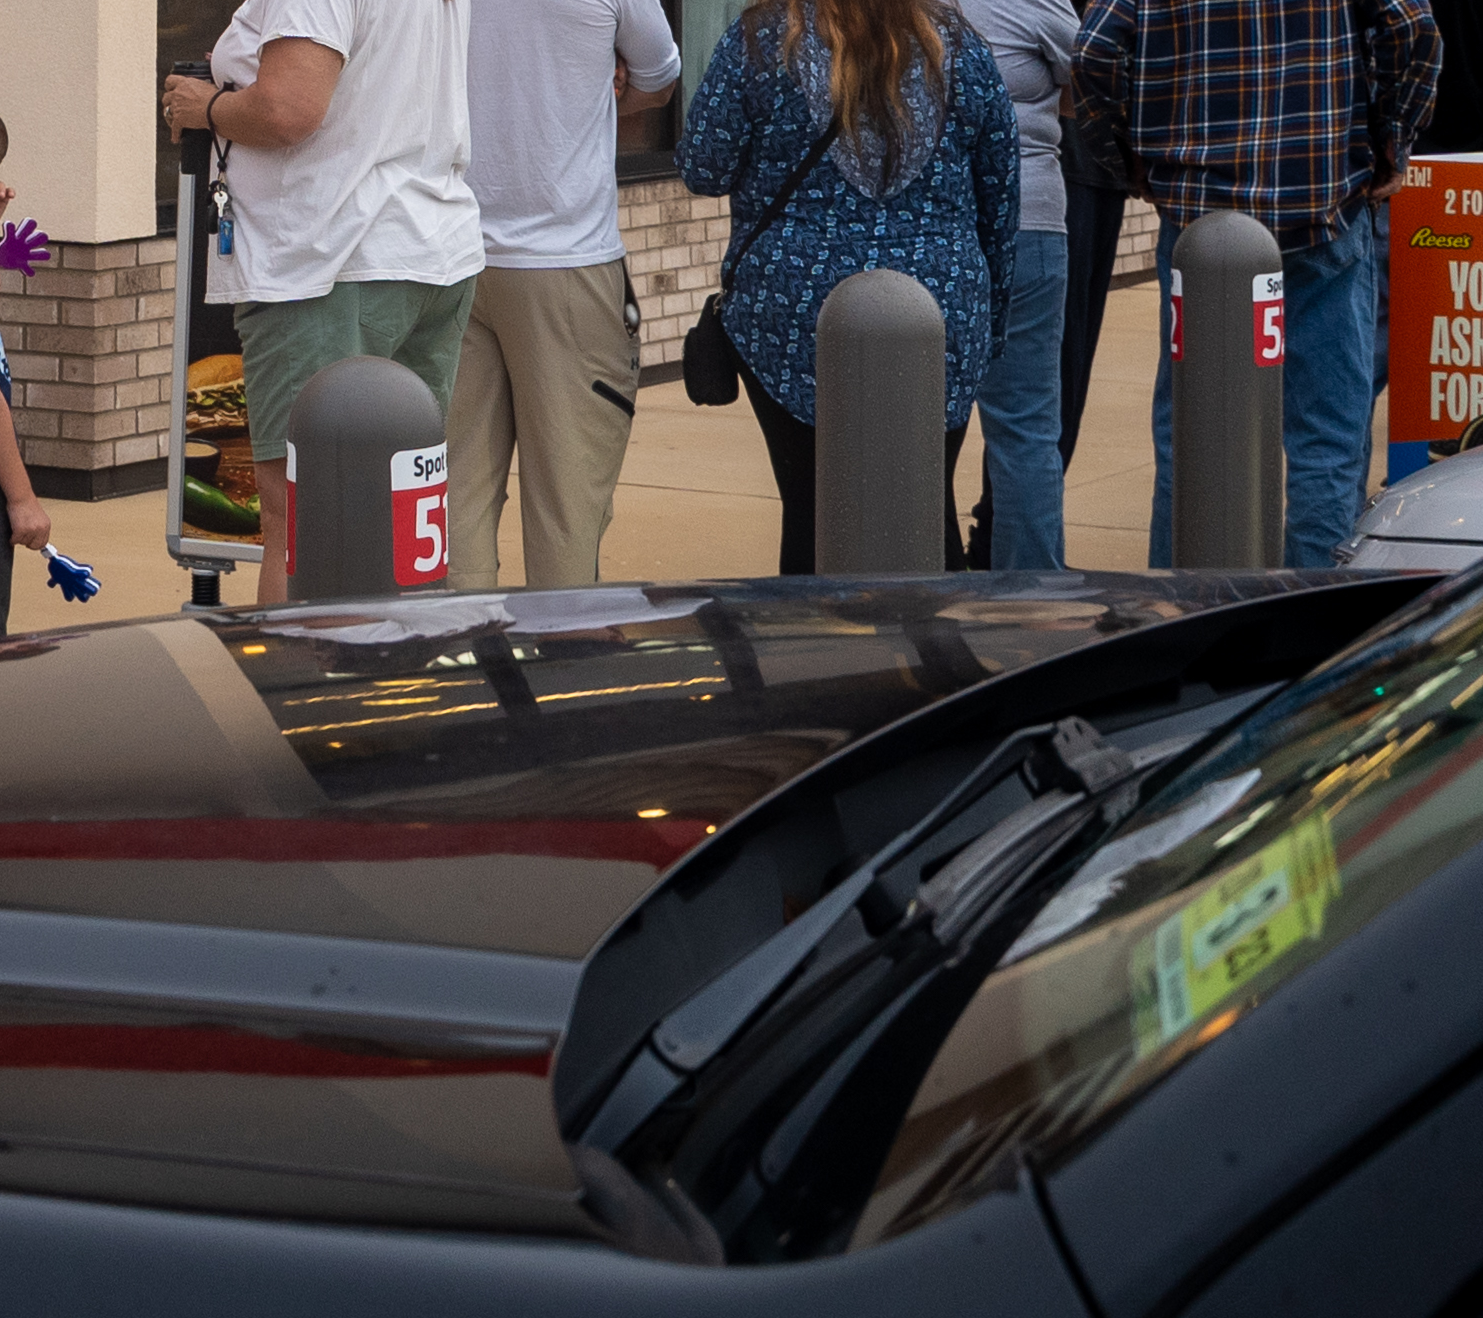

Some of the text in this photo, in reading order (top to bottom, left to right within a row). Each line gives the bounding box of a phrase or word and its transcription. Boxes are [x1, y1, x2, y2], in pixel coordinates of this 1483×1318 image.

[1444, 188, 1456, 215] 2
[1262, 304, 1285, 360] 5
[414, 452, 445, 482] Spot
